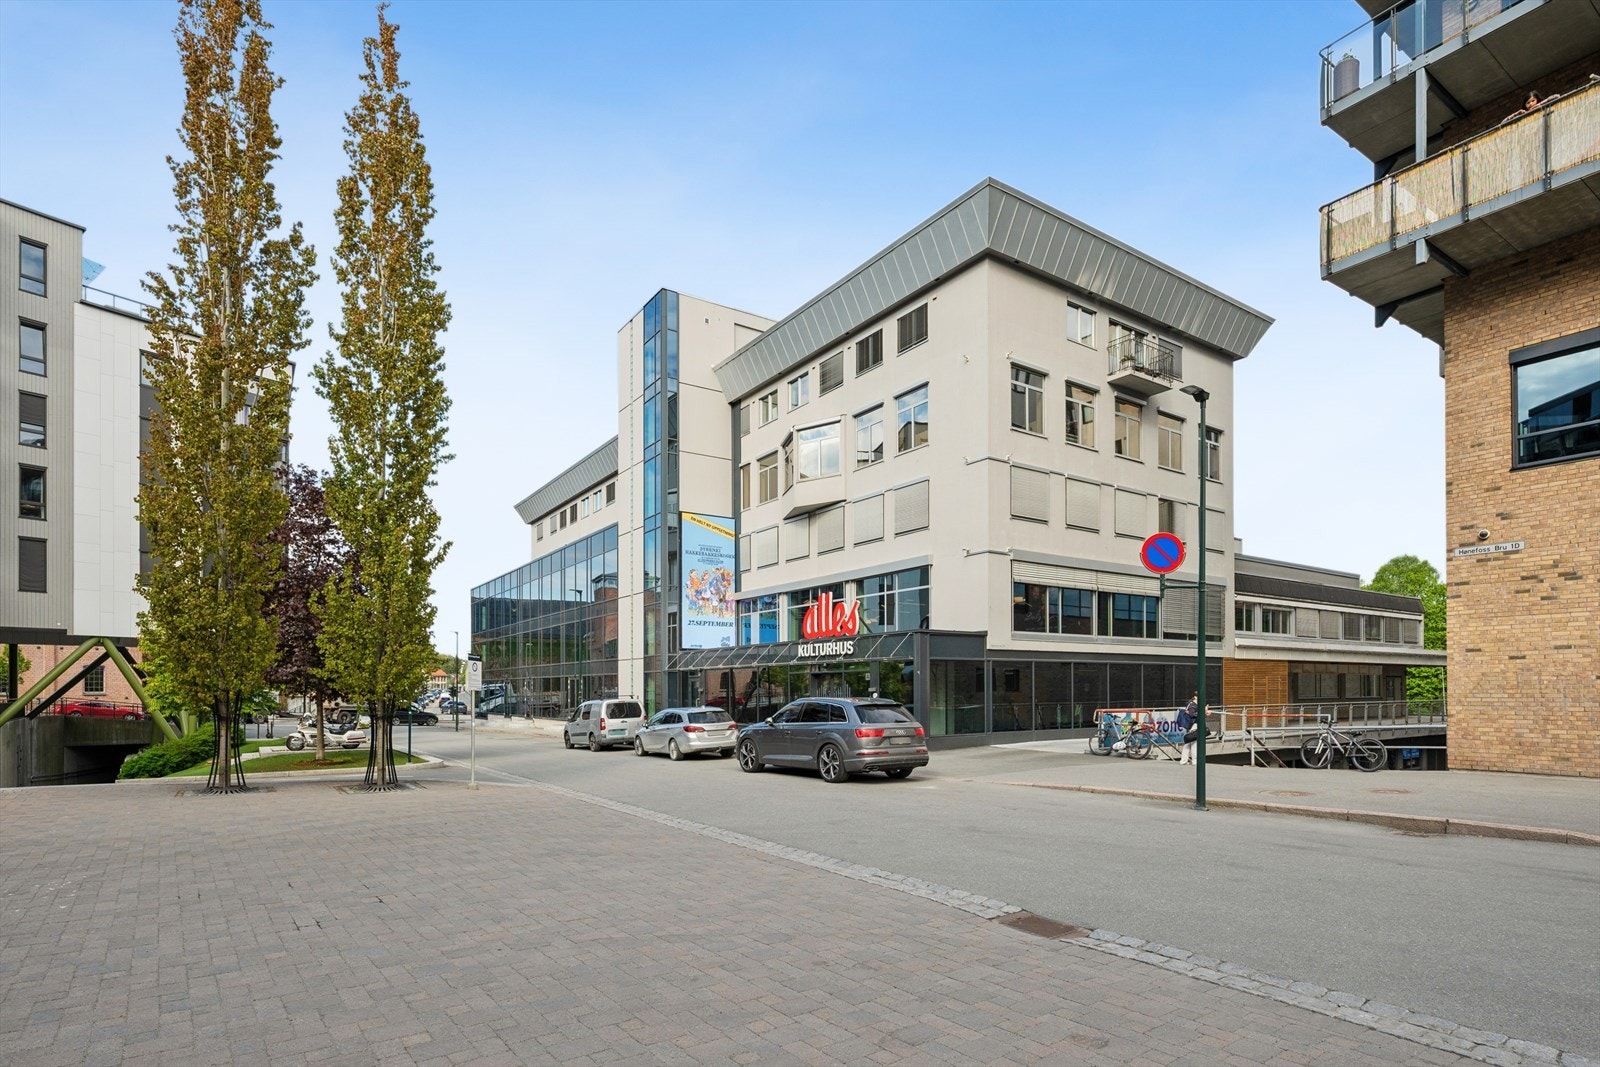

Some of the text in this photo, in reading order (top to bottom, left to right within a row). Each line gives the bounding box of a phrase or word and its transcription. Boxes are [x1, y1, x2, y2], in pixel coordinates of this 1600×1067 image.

[1458, 547, 1491, 555] Hønefoss
[802, 592, 860, 639] alles
[798, 641, 854, 657] KULTURHUS
